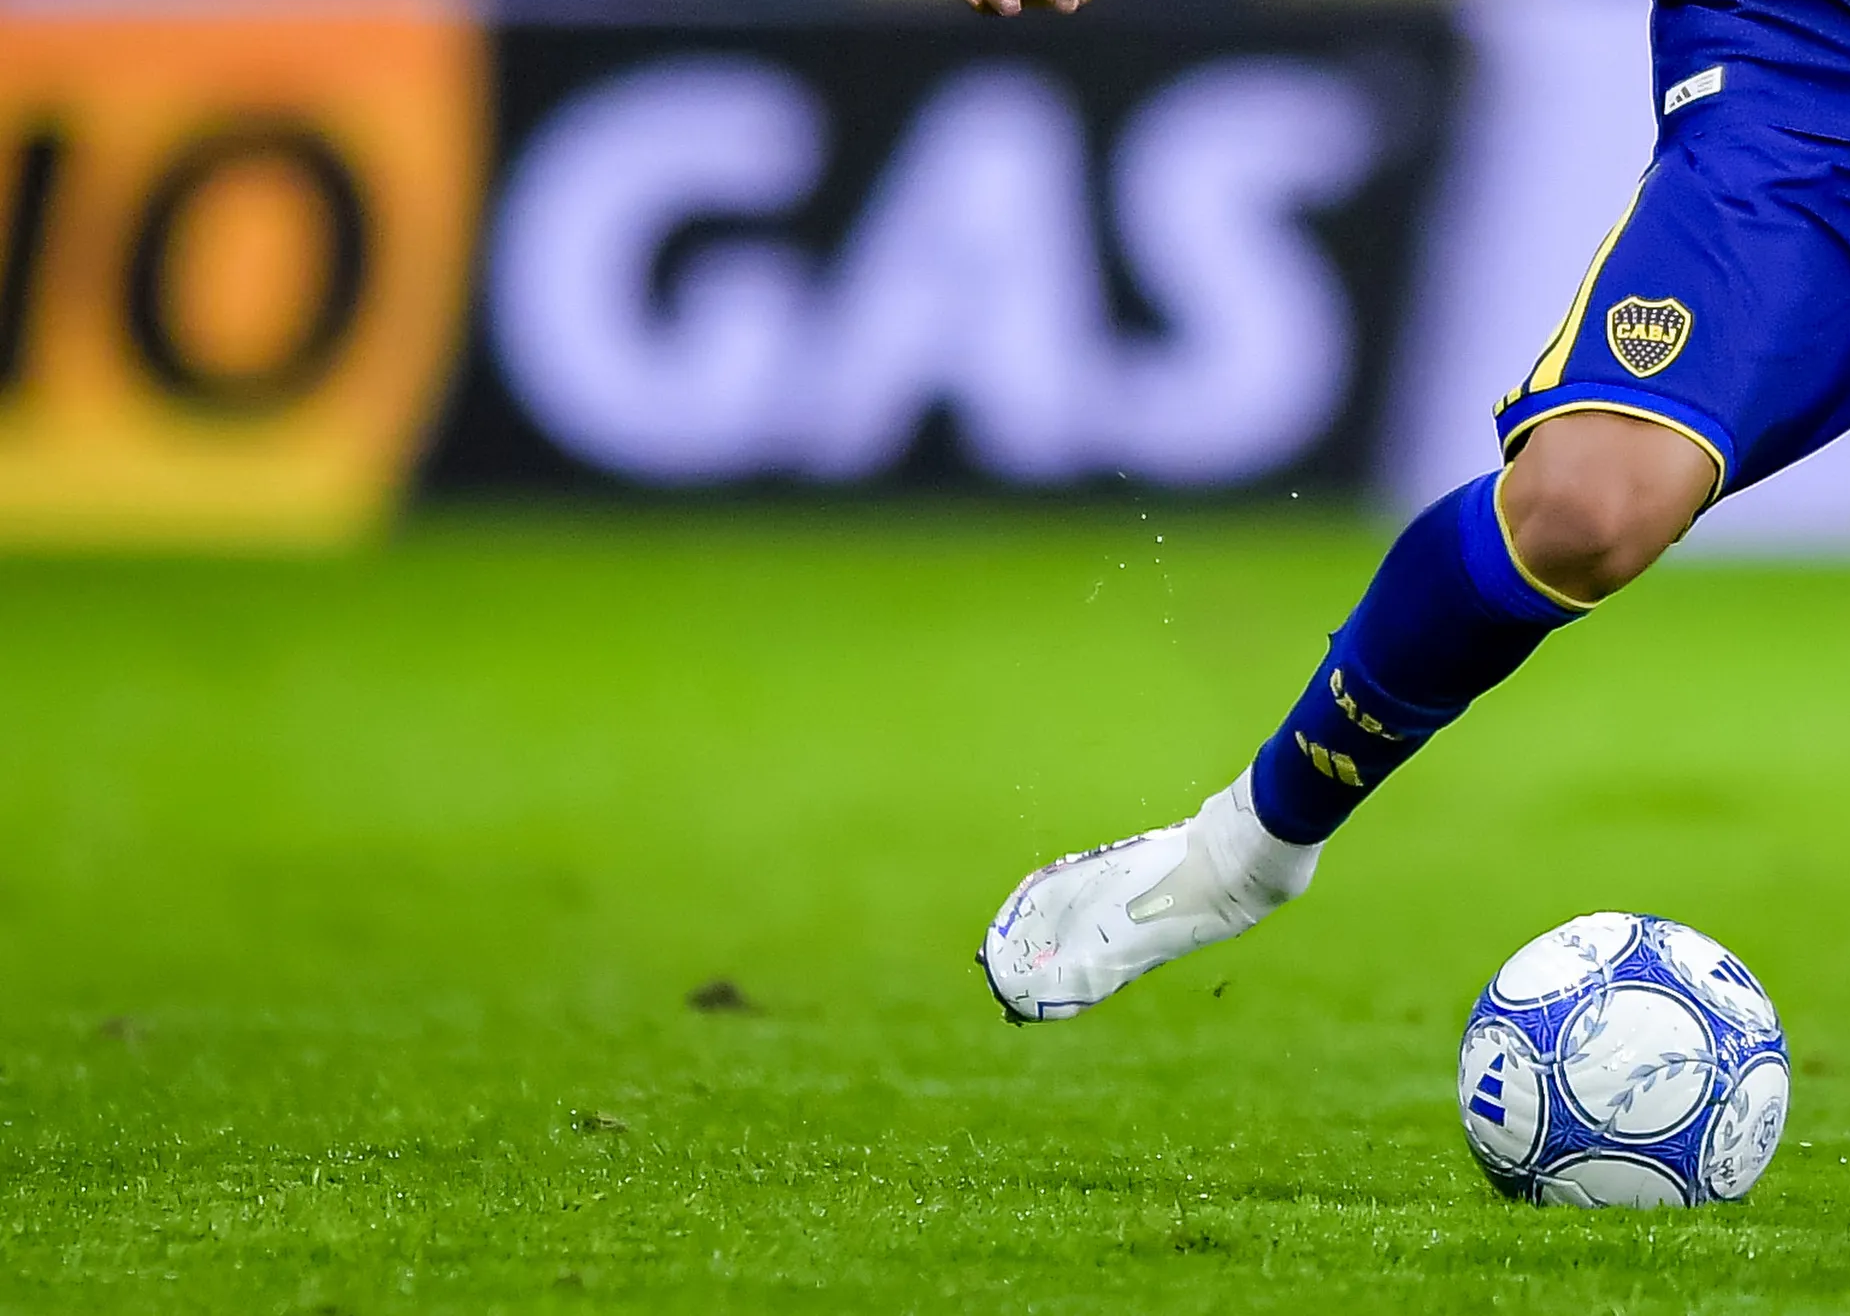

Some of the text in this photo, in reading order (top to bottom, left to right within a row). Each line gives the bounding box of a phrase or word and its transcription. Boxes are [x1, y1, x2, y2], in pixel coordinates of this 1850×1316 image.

[492, 54, 1375, 484] GAS
[1616, 323, 1677, 344] CABJ
[1329, 668, 1402, 741] CAB
